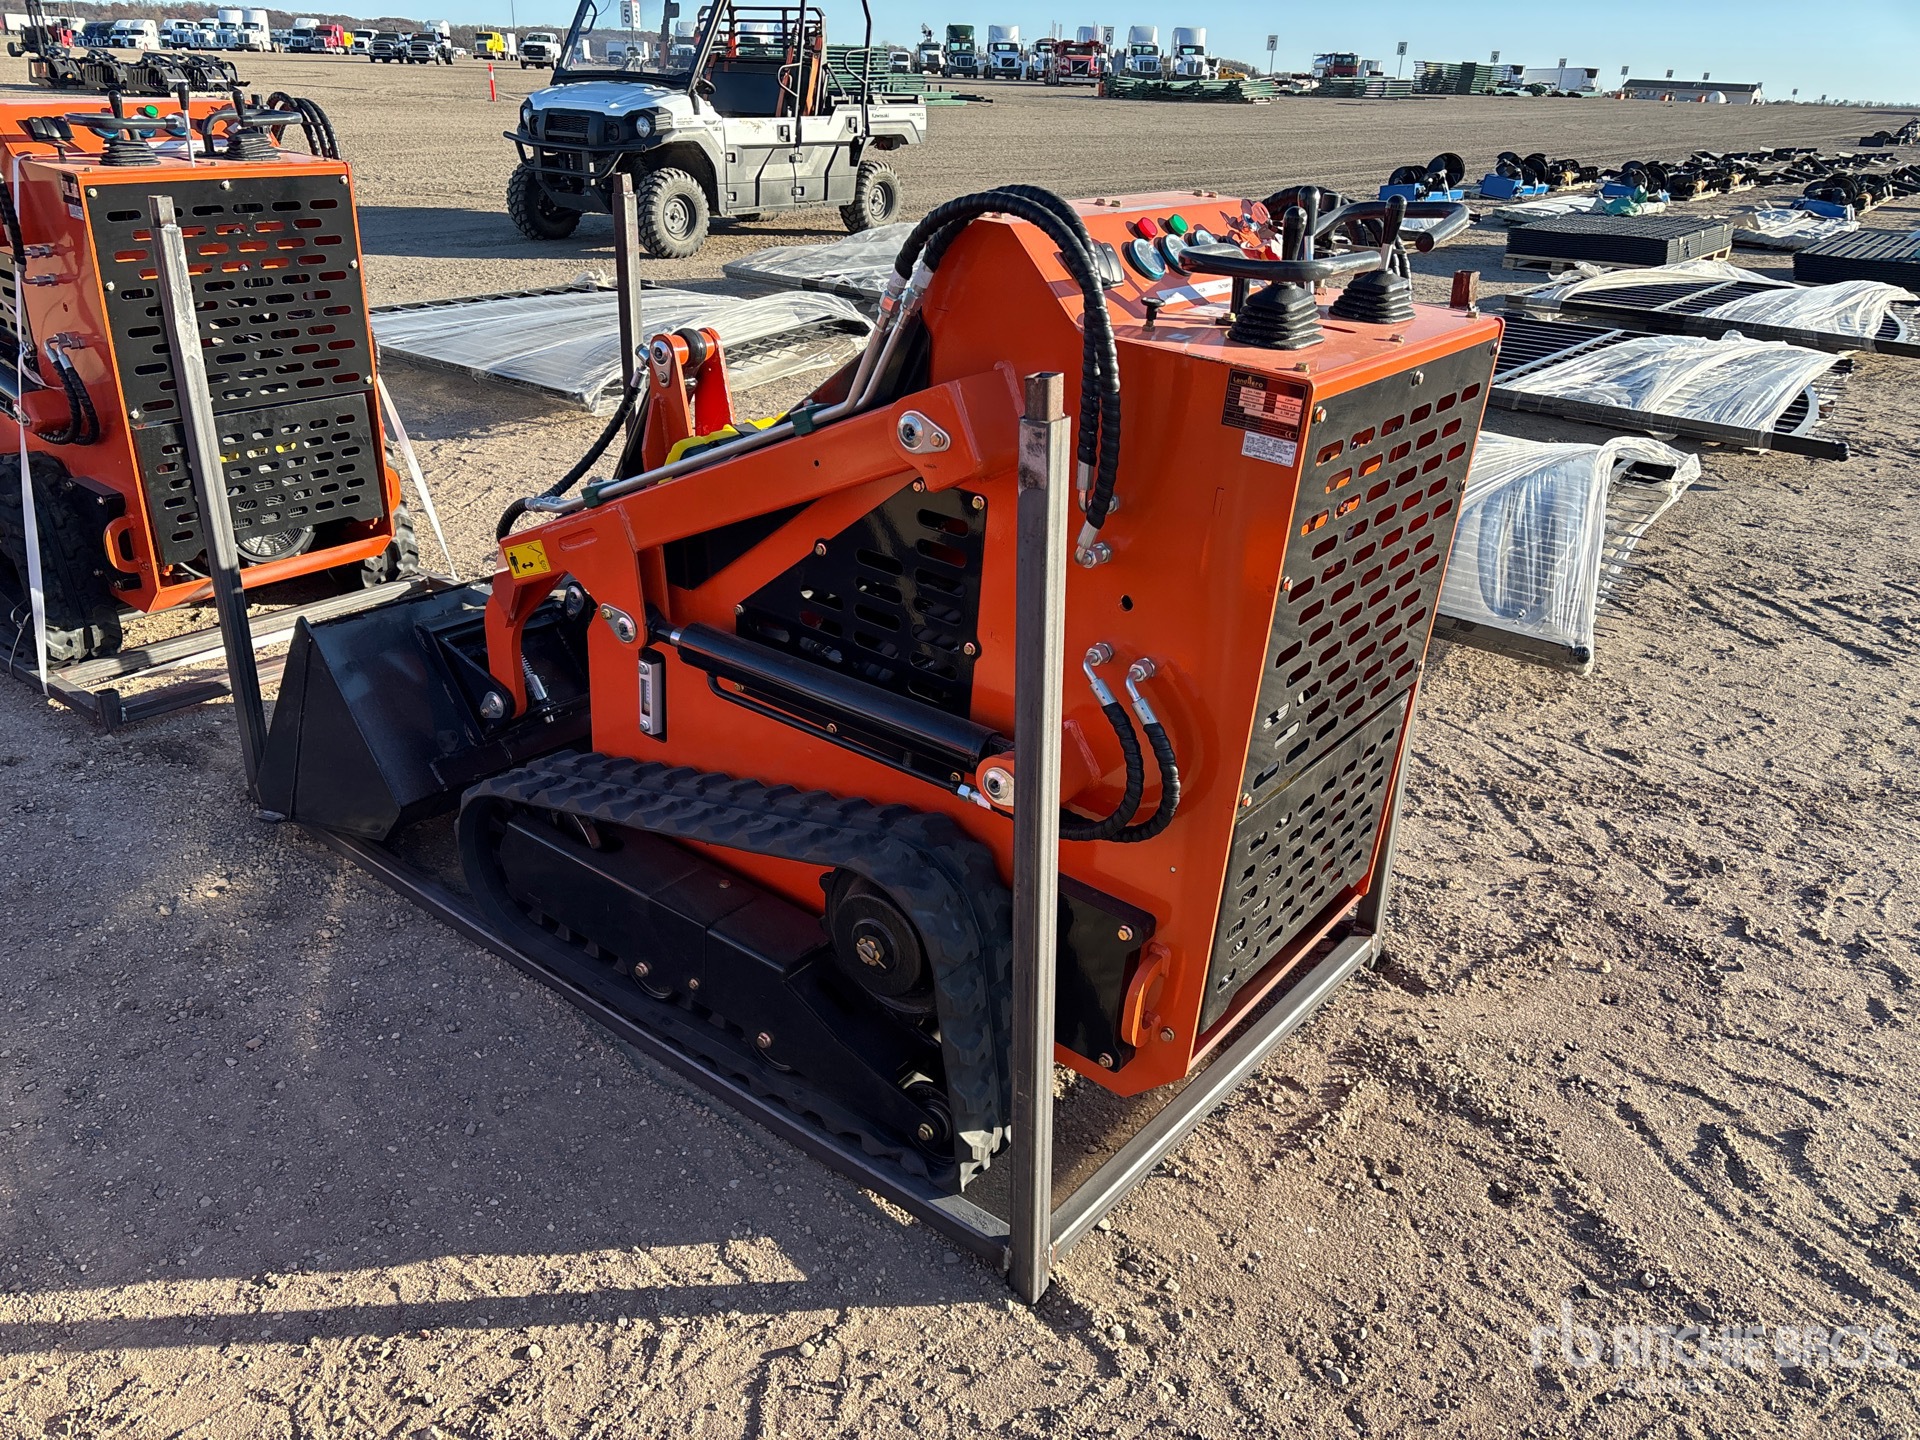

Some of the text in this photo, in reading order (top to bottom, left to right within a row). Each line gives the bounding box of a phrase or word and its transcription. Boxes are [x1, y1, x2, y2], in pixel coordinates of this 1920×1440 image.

[624, 9, 630, 23] 5
[1105, 32, 1111, 42] 6
[1270, 40, 1275, 49] 7
[1400, 45, 1405, 54] 8
